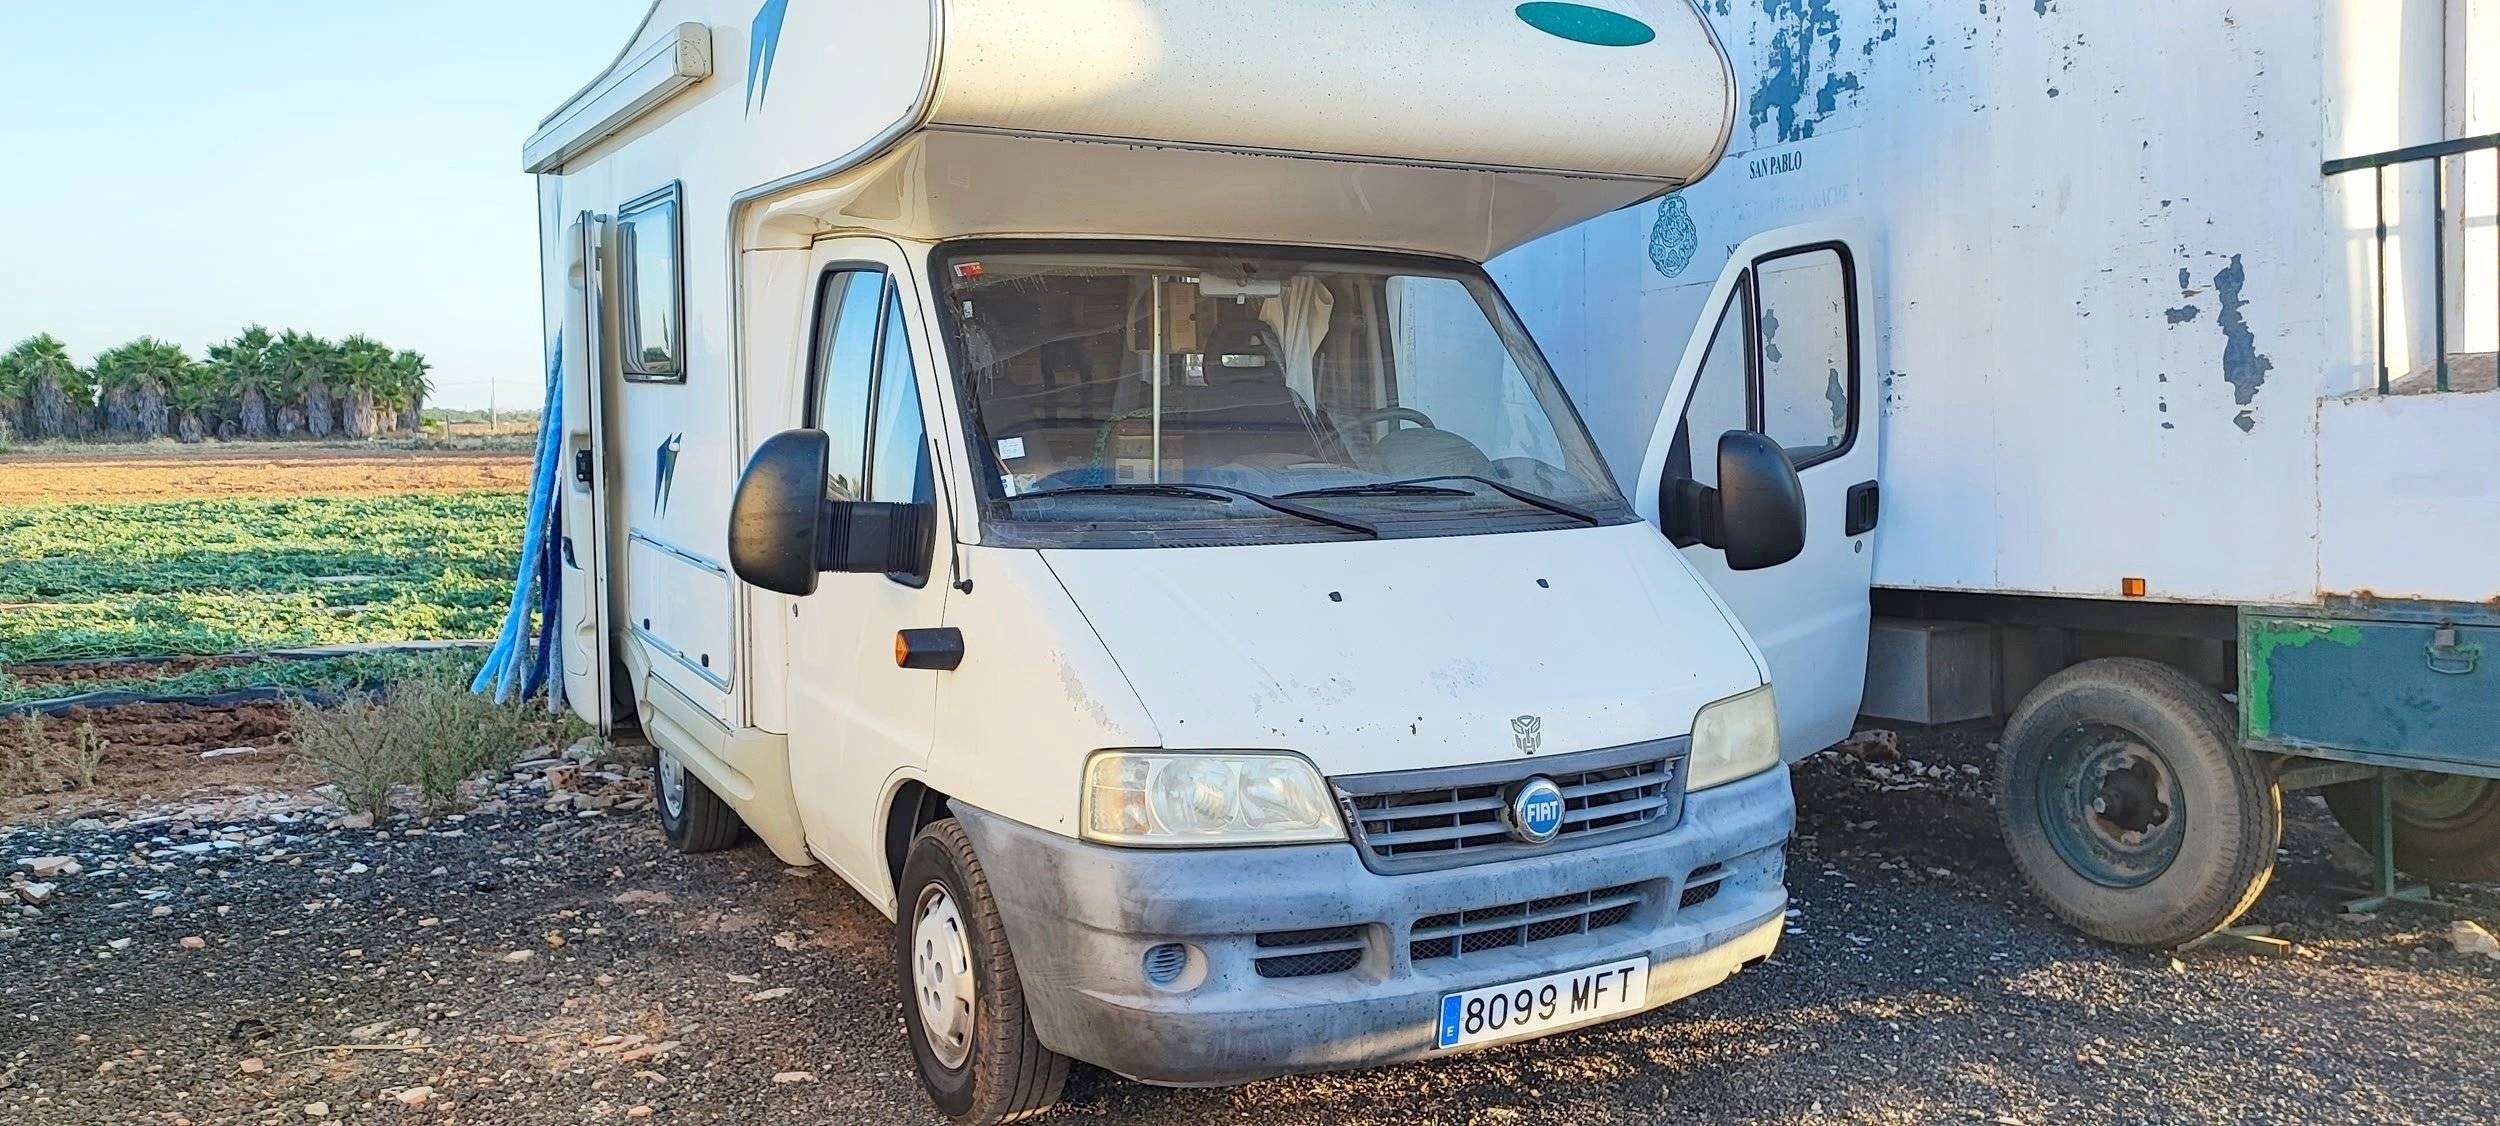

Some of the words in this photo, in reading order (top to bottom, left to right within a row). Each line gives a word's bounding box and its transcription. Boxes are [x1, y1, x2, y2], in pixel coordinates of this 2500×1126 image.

[1749, 158, 1768, 180] SAN
[1770, 150, 1802, 176] PABLO
[1527, 800, 1558, 823] FIAT
[1446, 1025, 1455, 1038] E
[1464, 984, 1558, 1035] 8099
[1570, 966, 1636, 1015] MFT
